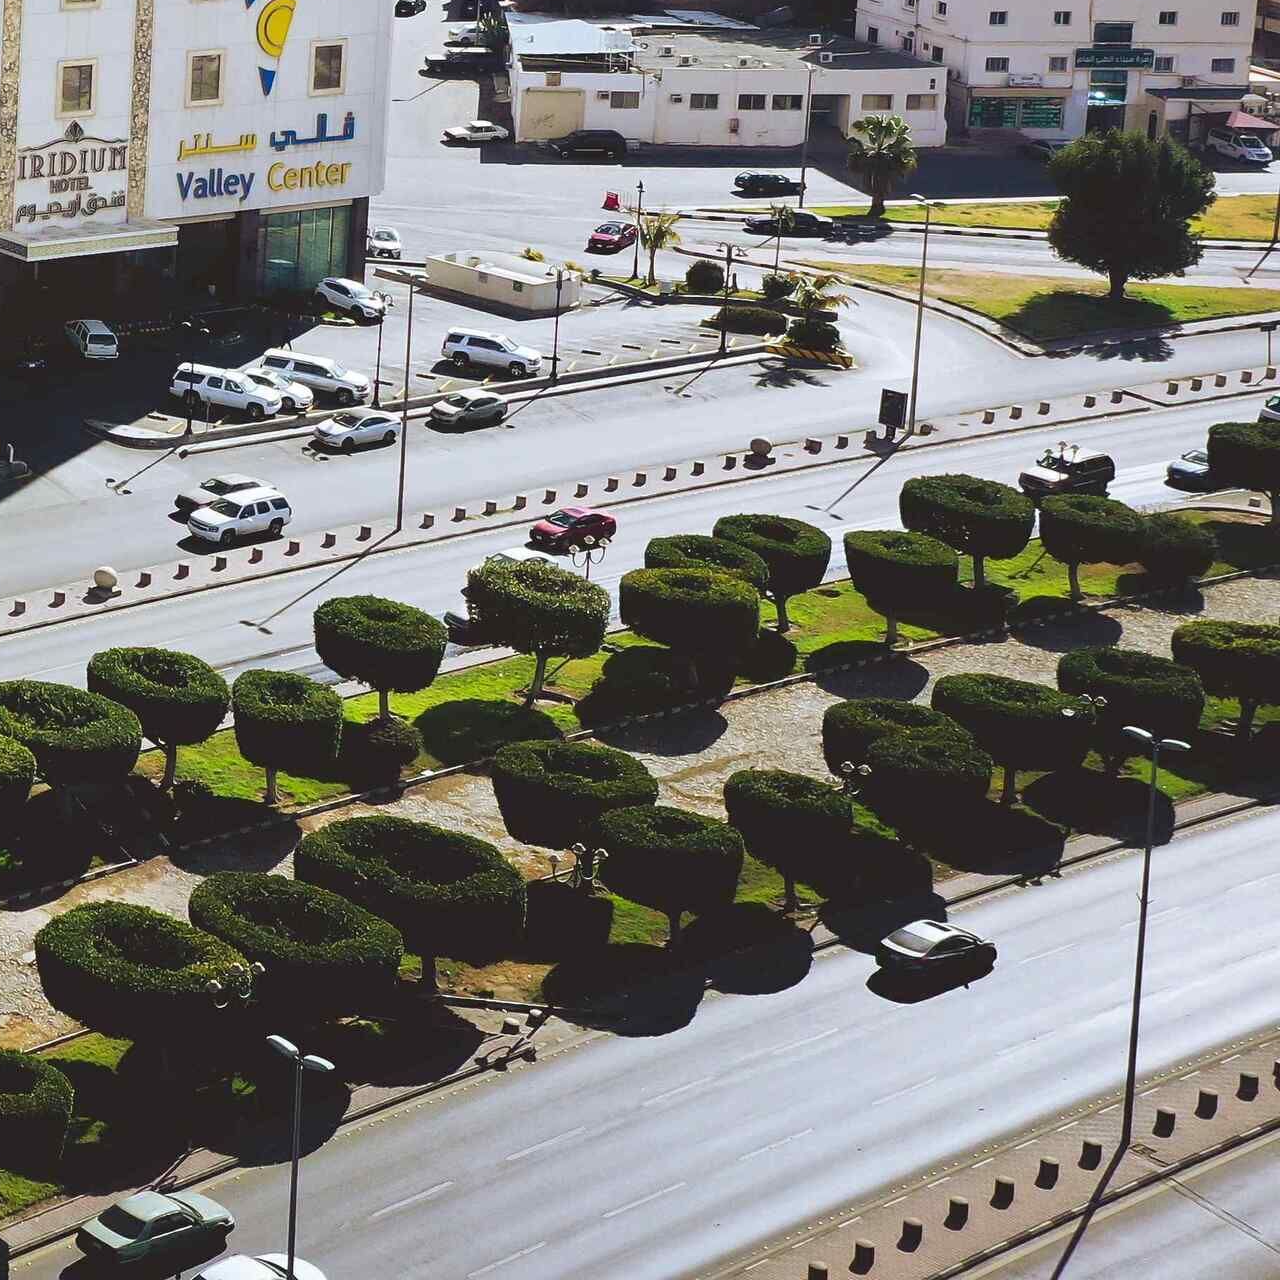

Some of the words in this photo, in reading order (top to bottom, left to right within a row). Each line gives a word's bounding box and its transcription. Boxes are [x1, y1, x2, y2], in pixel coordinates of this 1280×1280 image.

[17, 145, 128, 180] IRIDIUM
[49, 176, 93, 193] HOTEL
[176, 167, 255, 201] Valley
[267, 160, 352, 192] Center
